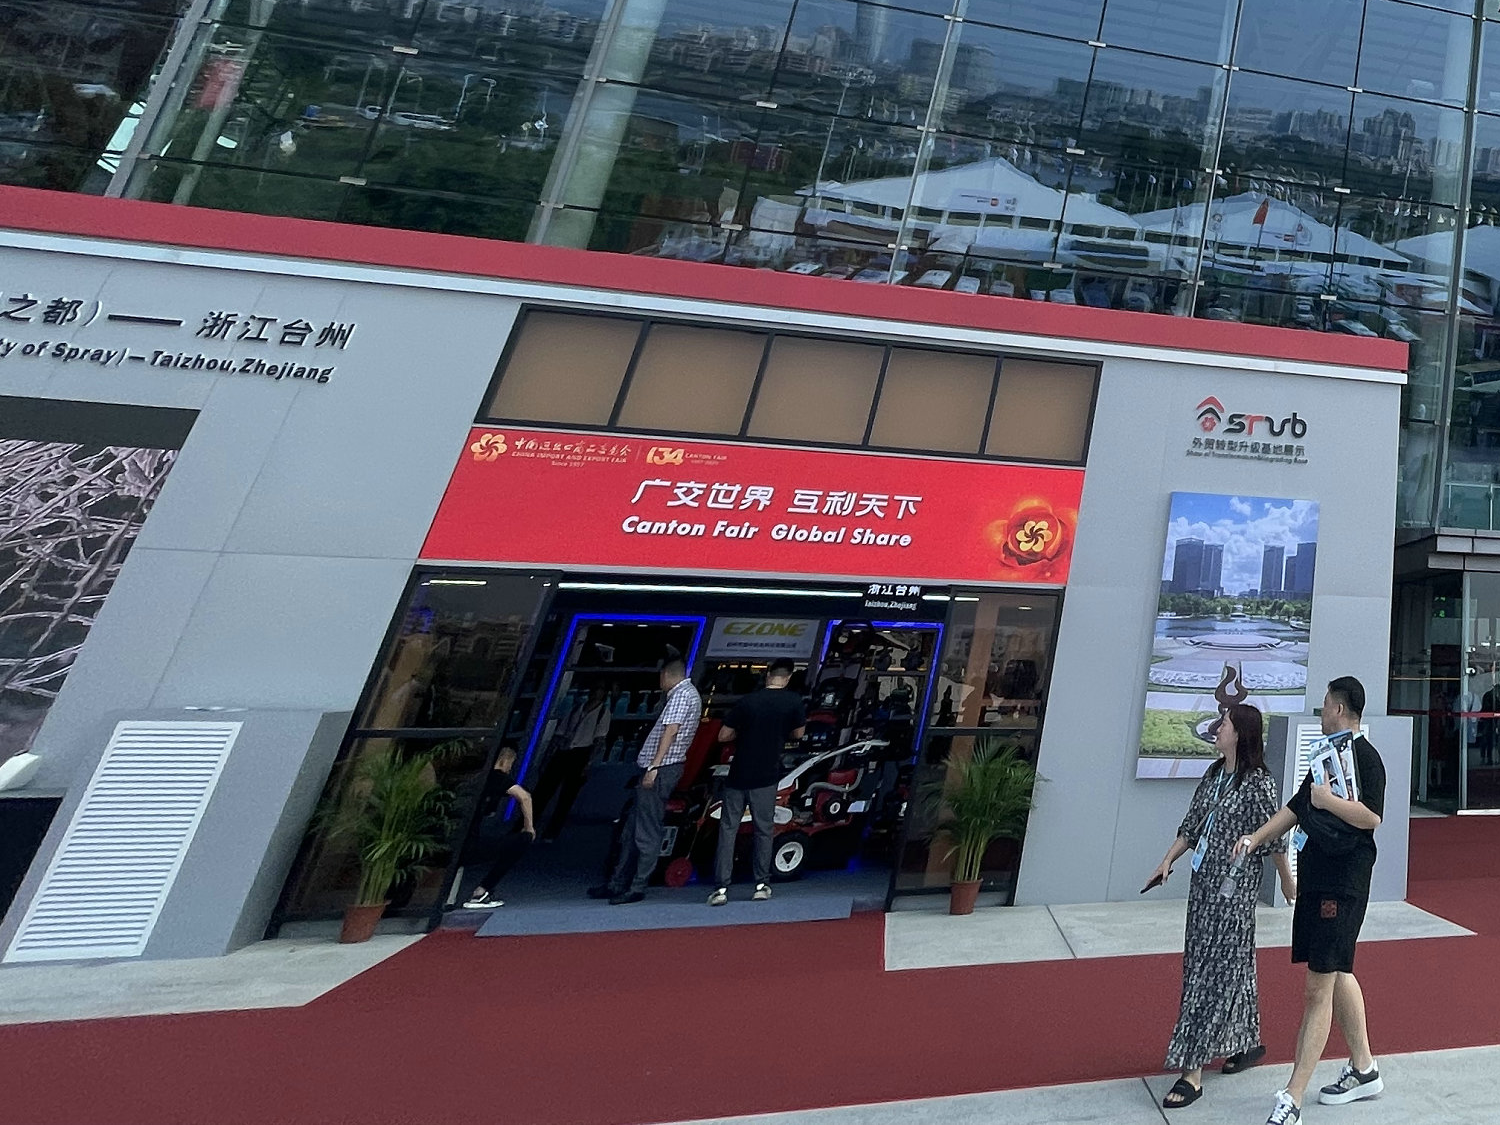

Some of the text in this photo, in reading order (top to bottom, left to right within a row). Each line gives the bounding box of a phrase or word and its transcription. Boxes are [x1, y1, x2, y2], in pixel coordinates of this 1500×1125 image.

[195, 309, 357, 350] 浙江台州
[22, 340, 50, 356] of
[646, 446, 685, 466] 134
[630, 478, 923, 520] 广交世界 互利天下
[621, 515, 912, 547] Canton Fair Global Share
[867, 583, 922, 597] 浙江台州
[723, 621, 809, 638] EZONE
